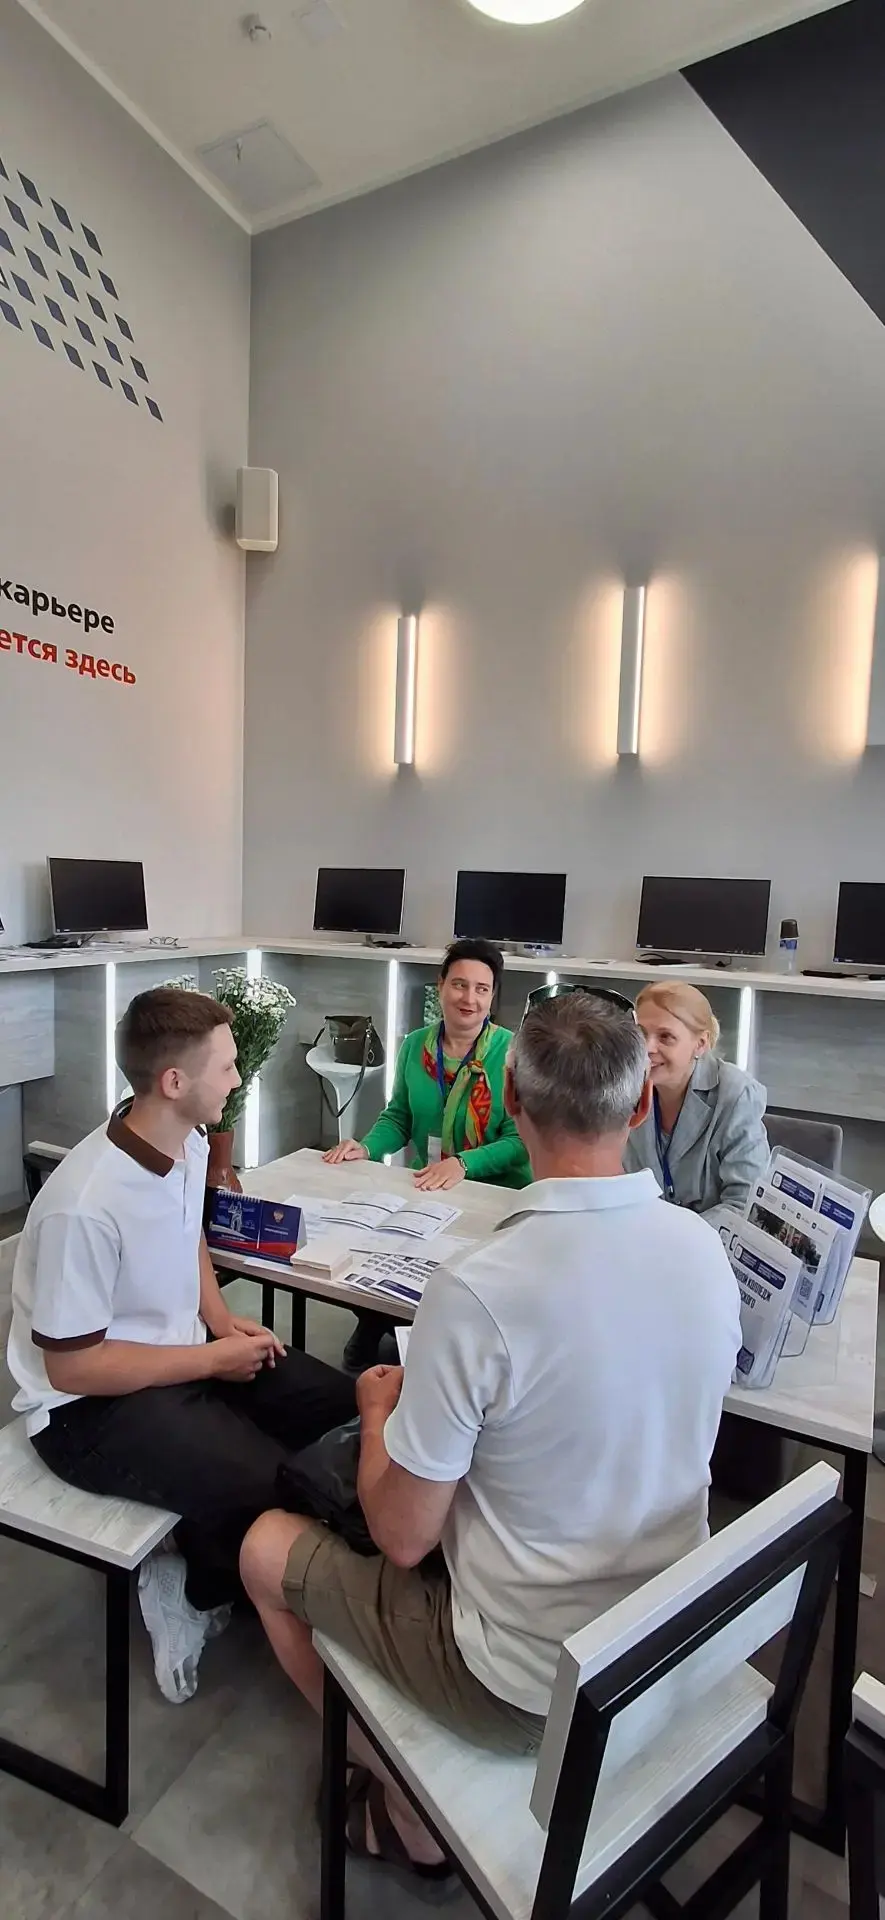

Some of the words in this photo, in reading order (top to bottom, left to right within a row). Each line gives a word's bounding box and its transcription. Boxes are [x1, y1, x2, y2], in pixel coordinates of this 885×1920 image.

[0, 578, 115, 634] карьере
[0, 628, 57, 664] ется
[65, 648, 137, 684] здесь
